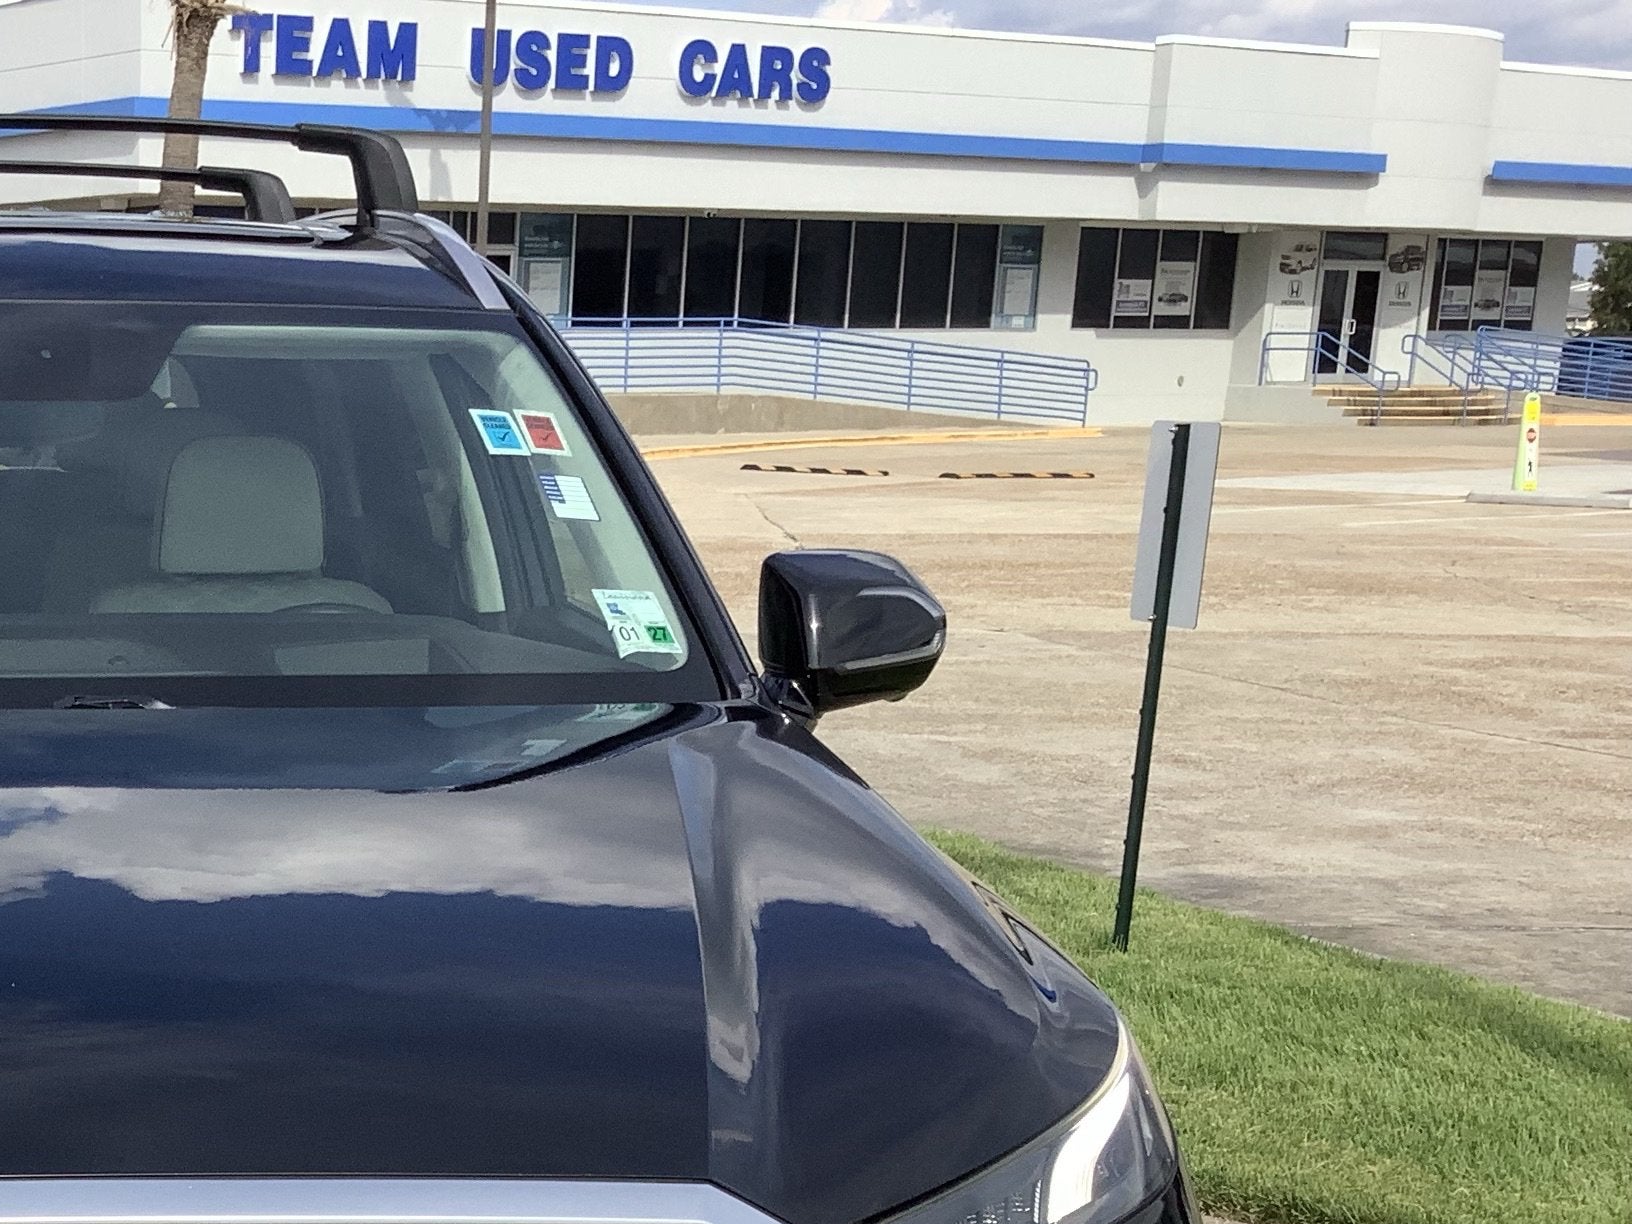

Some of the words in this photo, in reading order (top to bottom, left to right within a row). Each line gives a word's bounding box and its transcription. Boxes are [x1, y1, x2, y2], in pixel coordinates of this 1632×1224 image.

[231, 14, 418, 82] TEAM
[469, 28, 634, 93] USED
[679, 39, 832, 102] CARS
[619, 626, 640, 641] 01
[647, 627, 668, 641] 27
